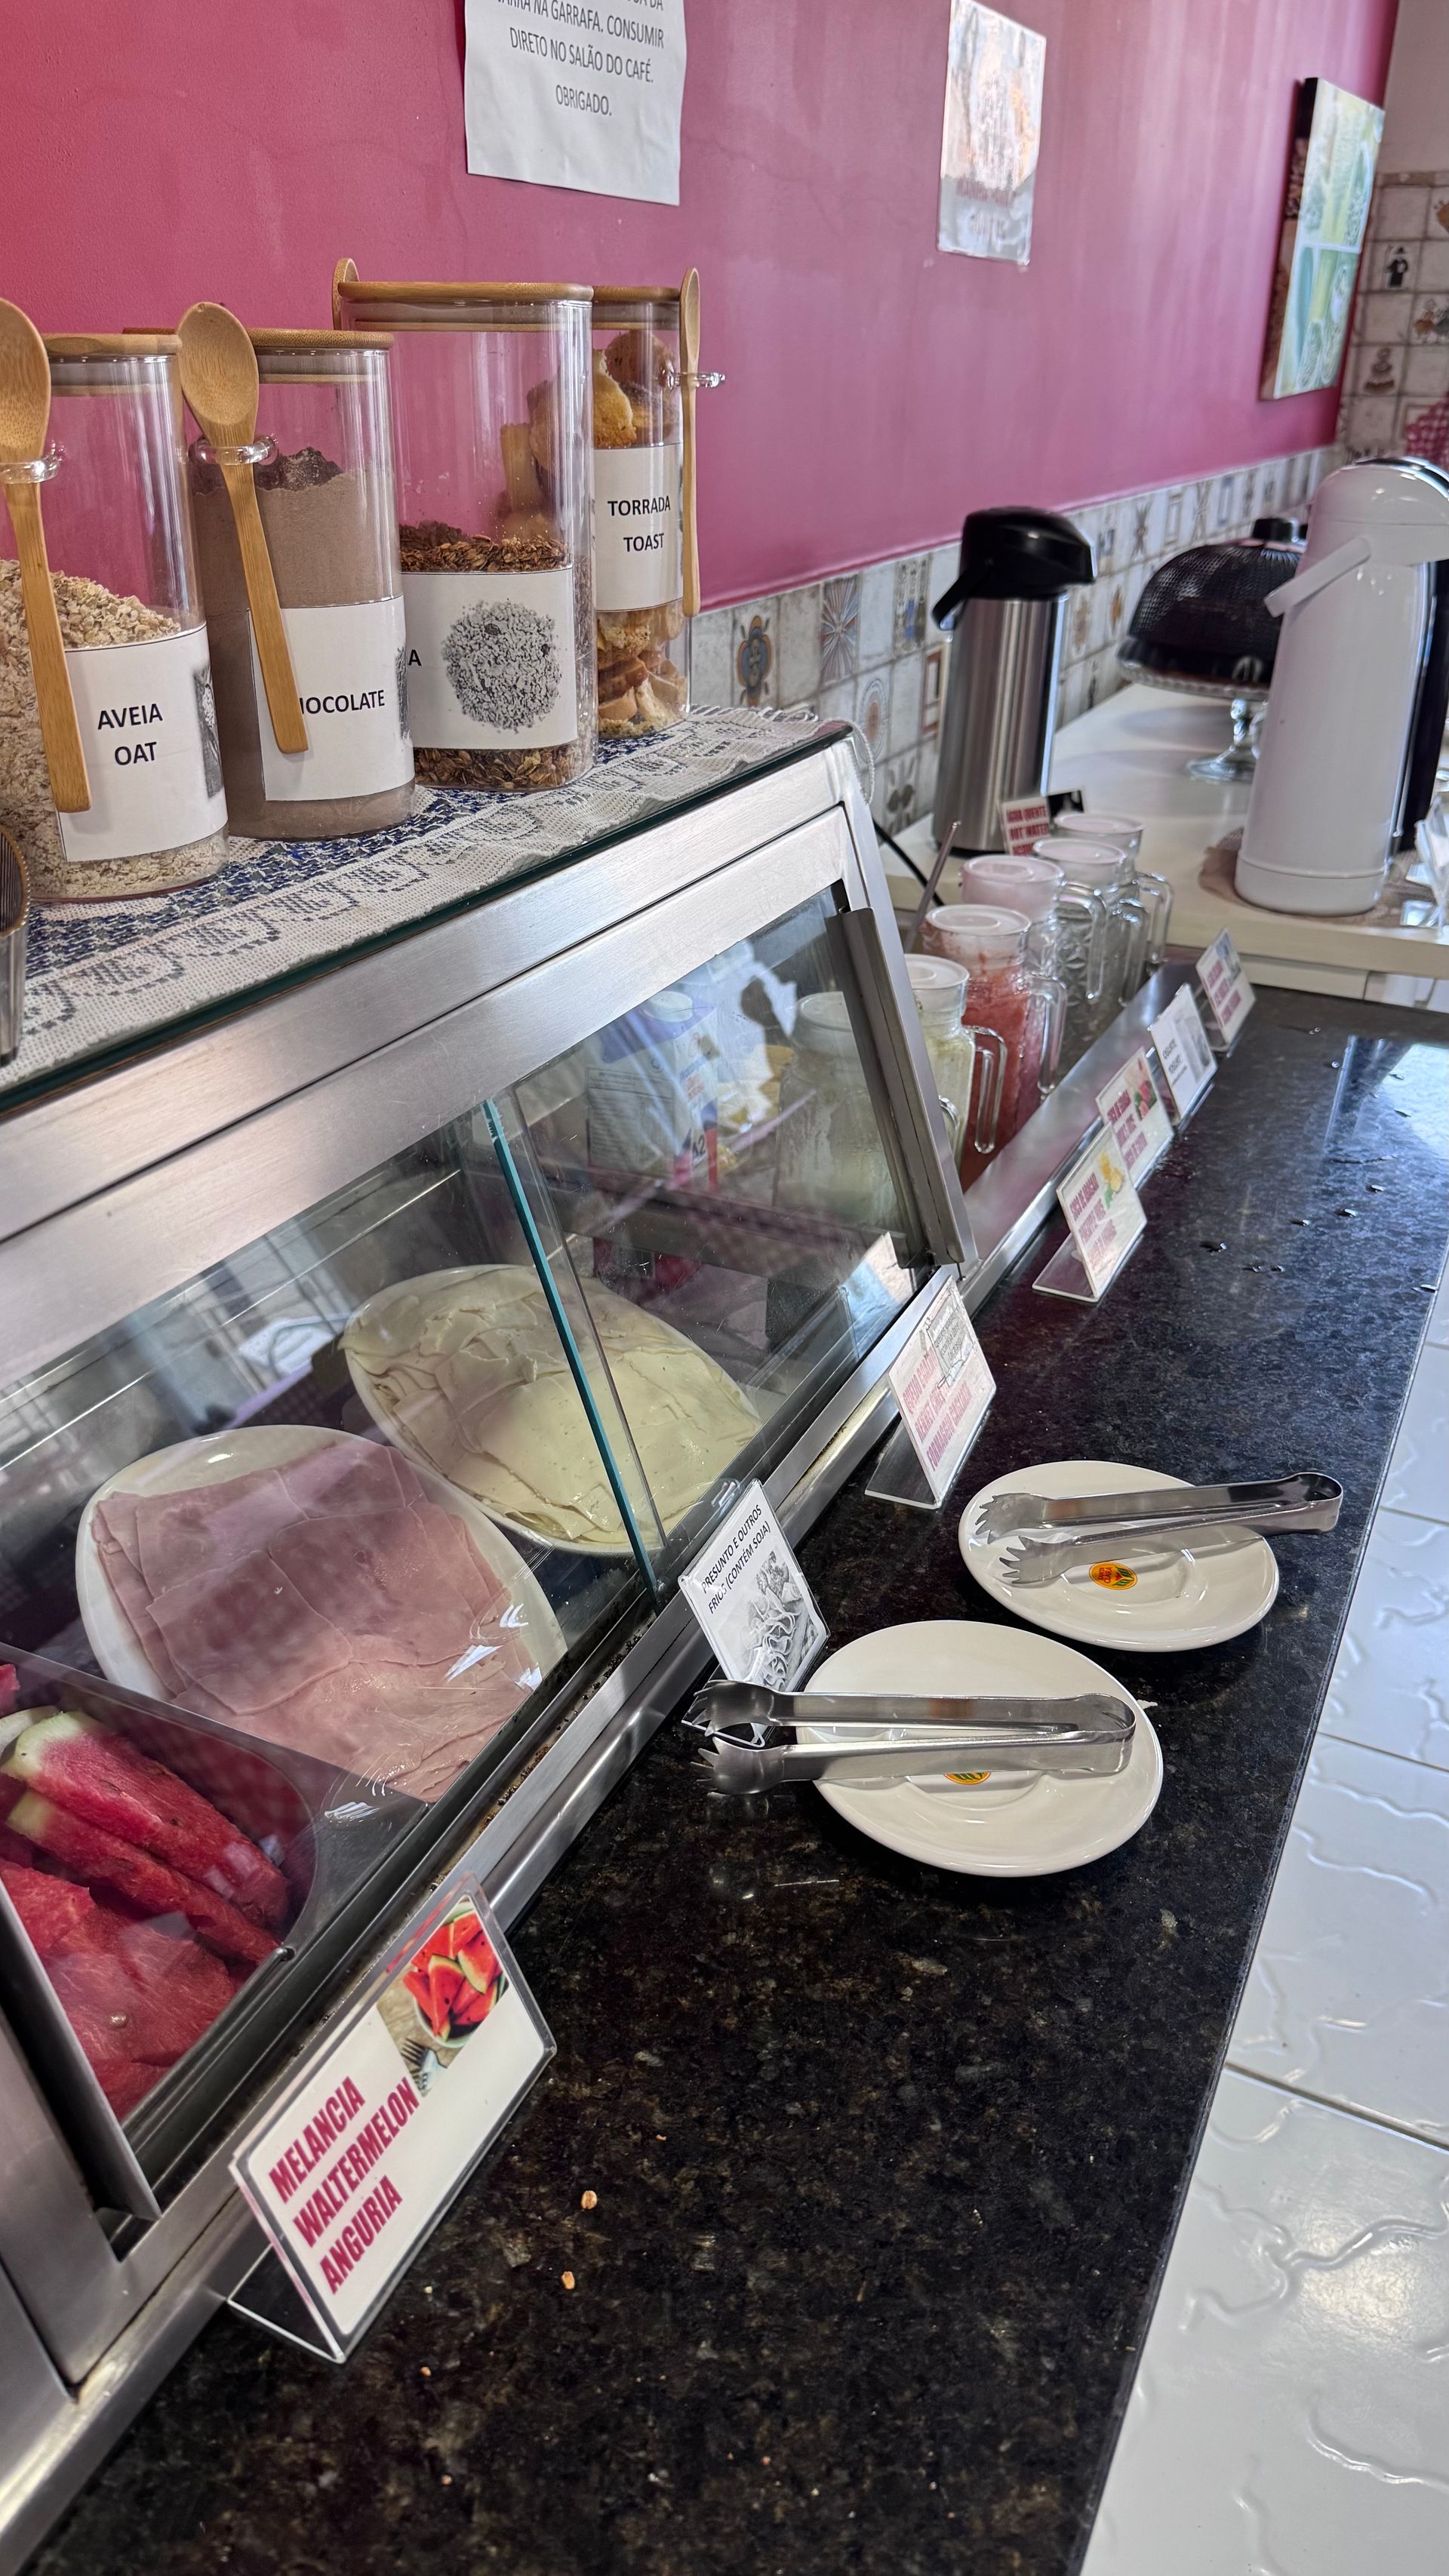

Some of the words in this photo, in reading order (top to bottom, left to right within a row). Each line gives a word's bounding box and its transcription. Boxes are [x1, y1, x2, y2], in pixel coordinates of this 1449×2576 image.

[551, 0, 604, 32] GARRAFA.
[606, 15, 665, 49] CONSUMIR
[509, 27, 548, 57] DIRETO
[550, 39, 567, 62] NO
[569, 44, 603, 71] SALÃO
[606, 54, 623, 75] DO
[625, 58, 654, 83] CAFÉ.
[555, 85, 612, 116] OBRIGADO.
[607, 495, 671, 516] TORRADA
[623, 533, 664, 552] TOAST
[97, 703, 163, 731] AVEIA
[299, 689, 386, 715] OCOLATE
[114, 741, 157, 766] OAT
[926, 1412, 955, 1472] FORMAGGIO
[701, 1544, 734, 1594] PRESUNTO
[733, 1537, 739, 1550] E
[737, 1504, 762, 1542] OUTROS
[708, 1583, 728, 1614] FRIOS
[725, 1543, 755, 1590] (CONTÉM
[753, 1520, 771, 1550] SOJA)
[268, 2075, 367, 2205] MELANCIA
[292, 2076, 420, 2249] WALTERMELON
[319, 2174, 404, 2296] ANGURIA
